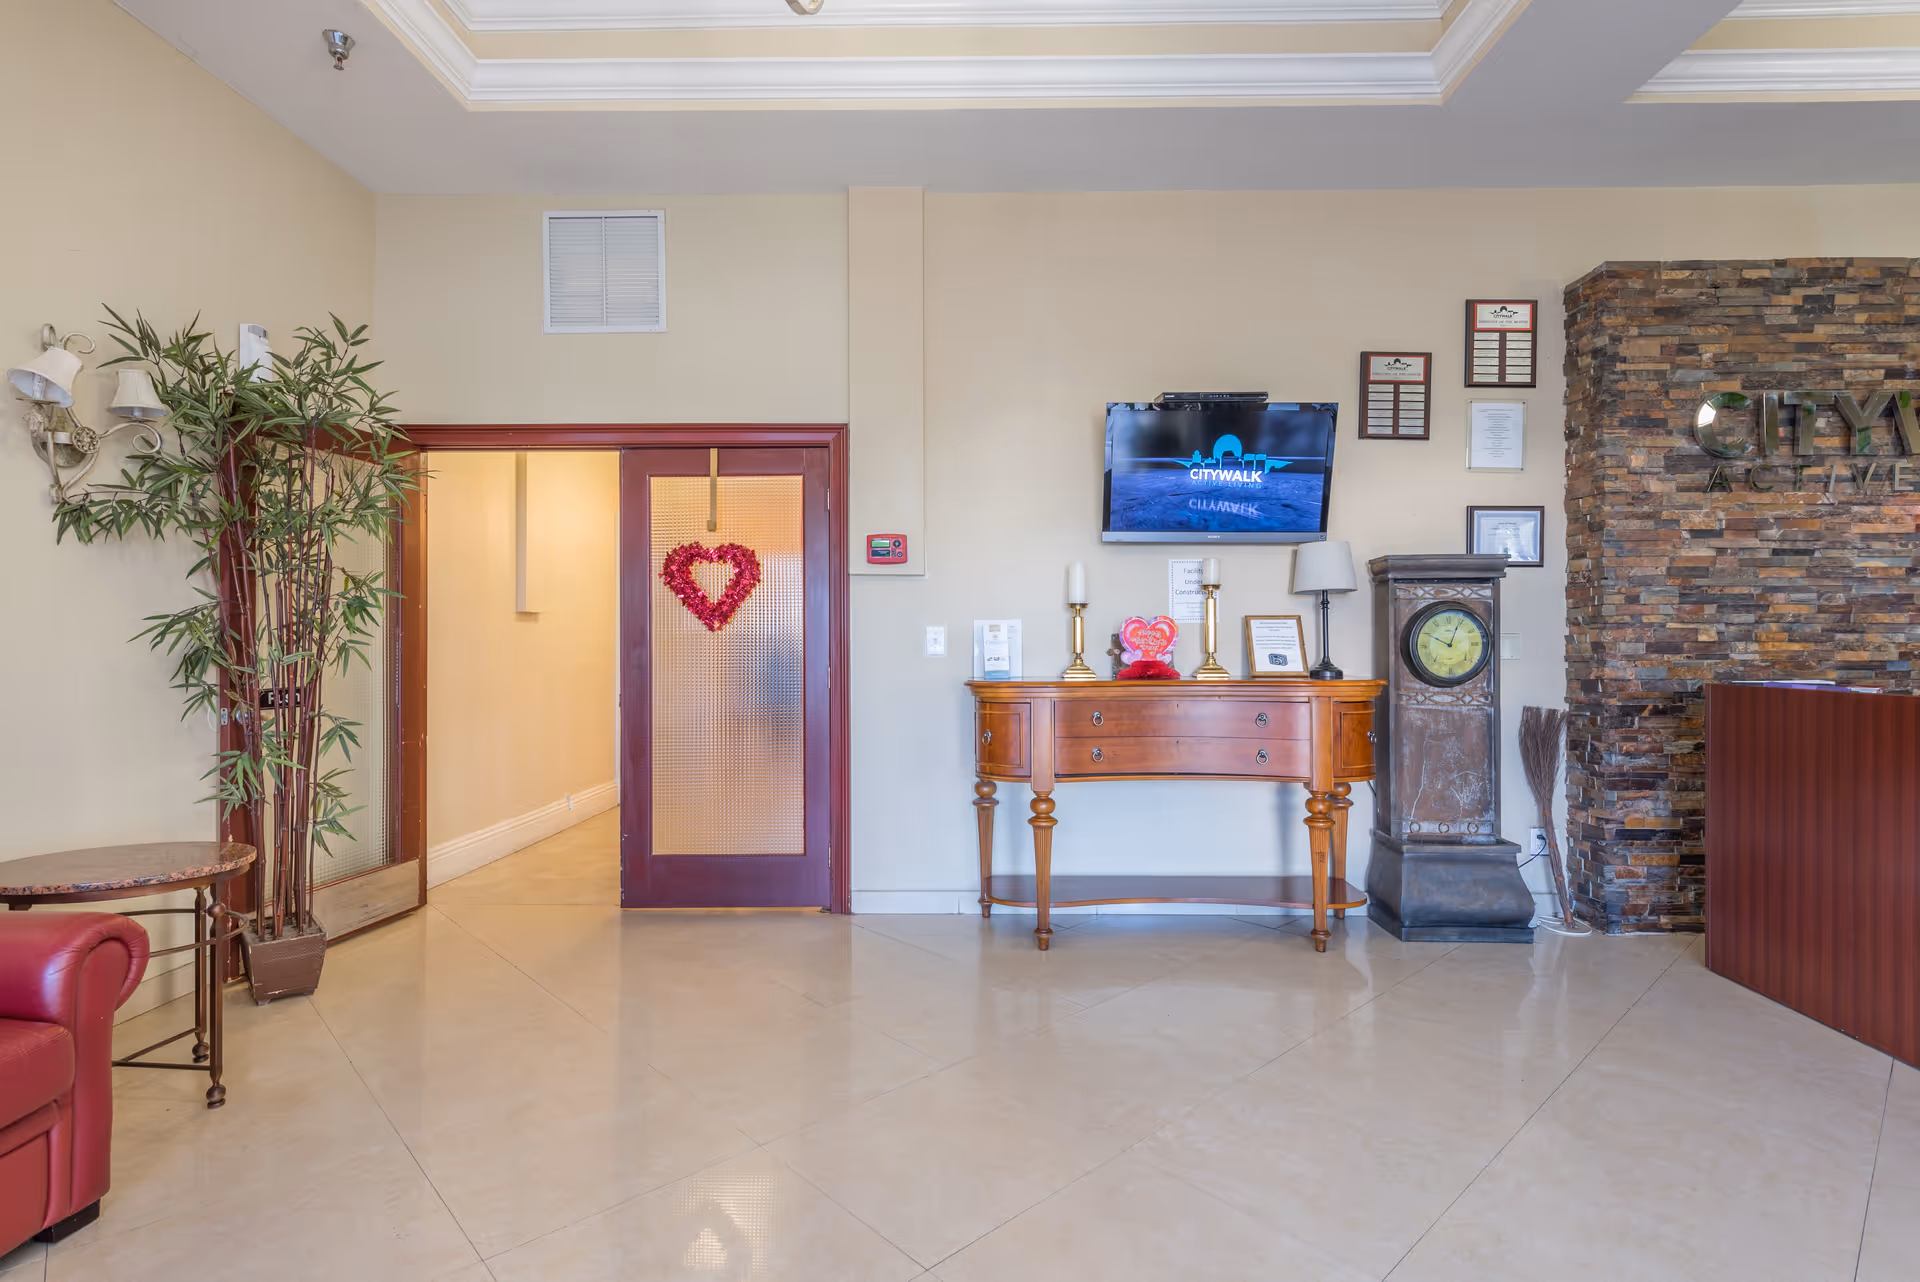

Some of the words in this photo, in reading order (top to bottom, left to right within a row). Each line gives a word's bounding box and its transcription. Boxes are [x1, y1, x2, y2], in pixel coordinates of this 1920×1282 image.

[1695, 390, 1920, 458] CITY
[1190, 468, 1263, 483] CITYWALK
[1704, 462, 1914, 493] ACTIVE
[1184, 568, 1204, 576] Facility
